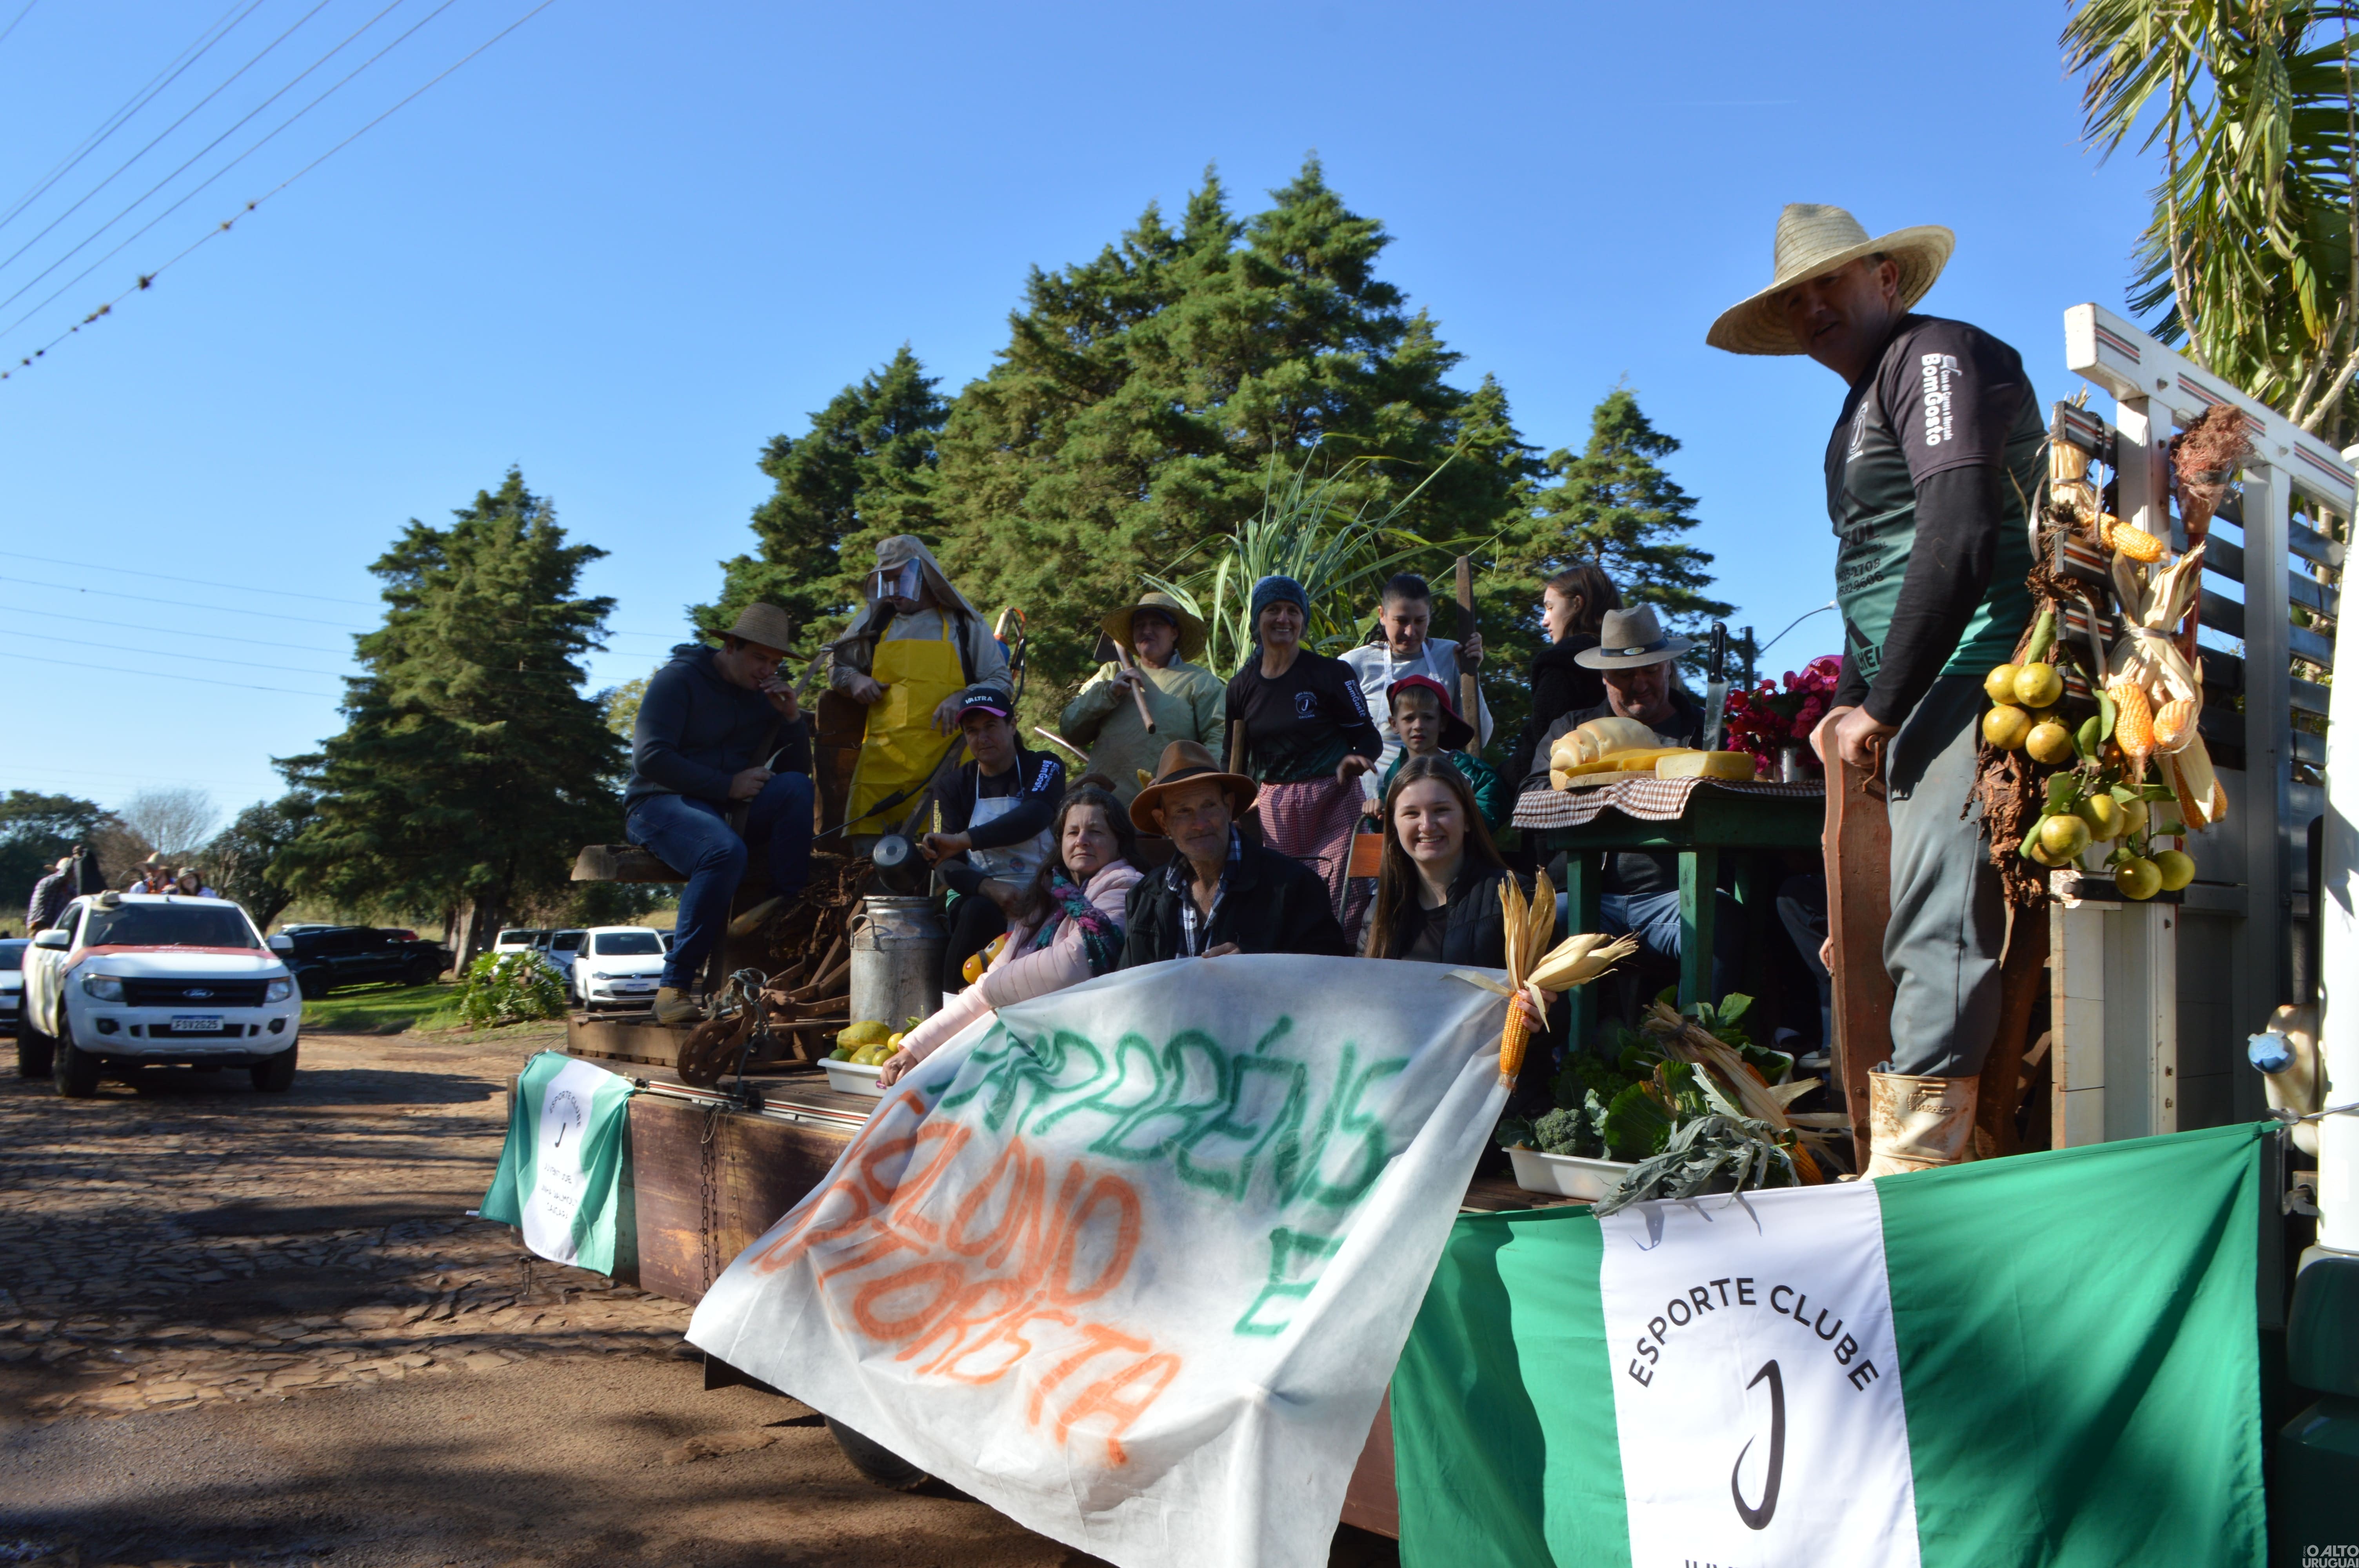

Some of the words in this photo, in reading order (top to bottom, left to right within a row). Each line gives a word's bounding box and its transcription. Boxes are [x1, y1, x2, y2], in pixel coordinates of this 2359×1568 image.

[1921, 353, 1943, 446] BomGosto
[965, 696, 993, 704] VALTRA
[1233, 1225, 1346, 1337] E
[1628, 1277, 1757, 1387] ESPORTE
[1770, 1285, 1879, 1391] CLUBE
